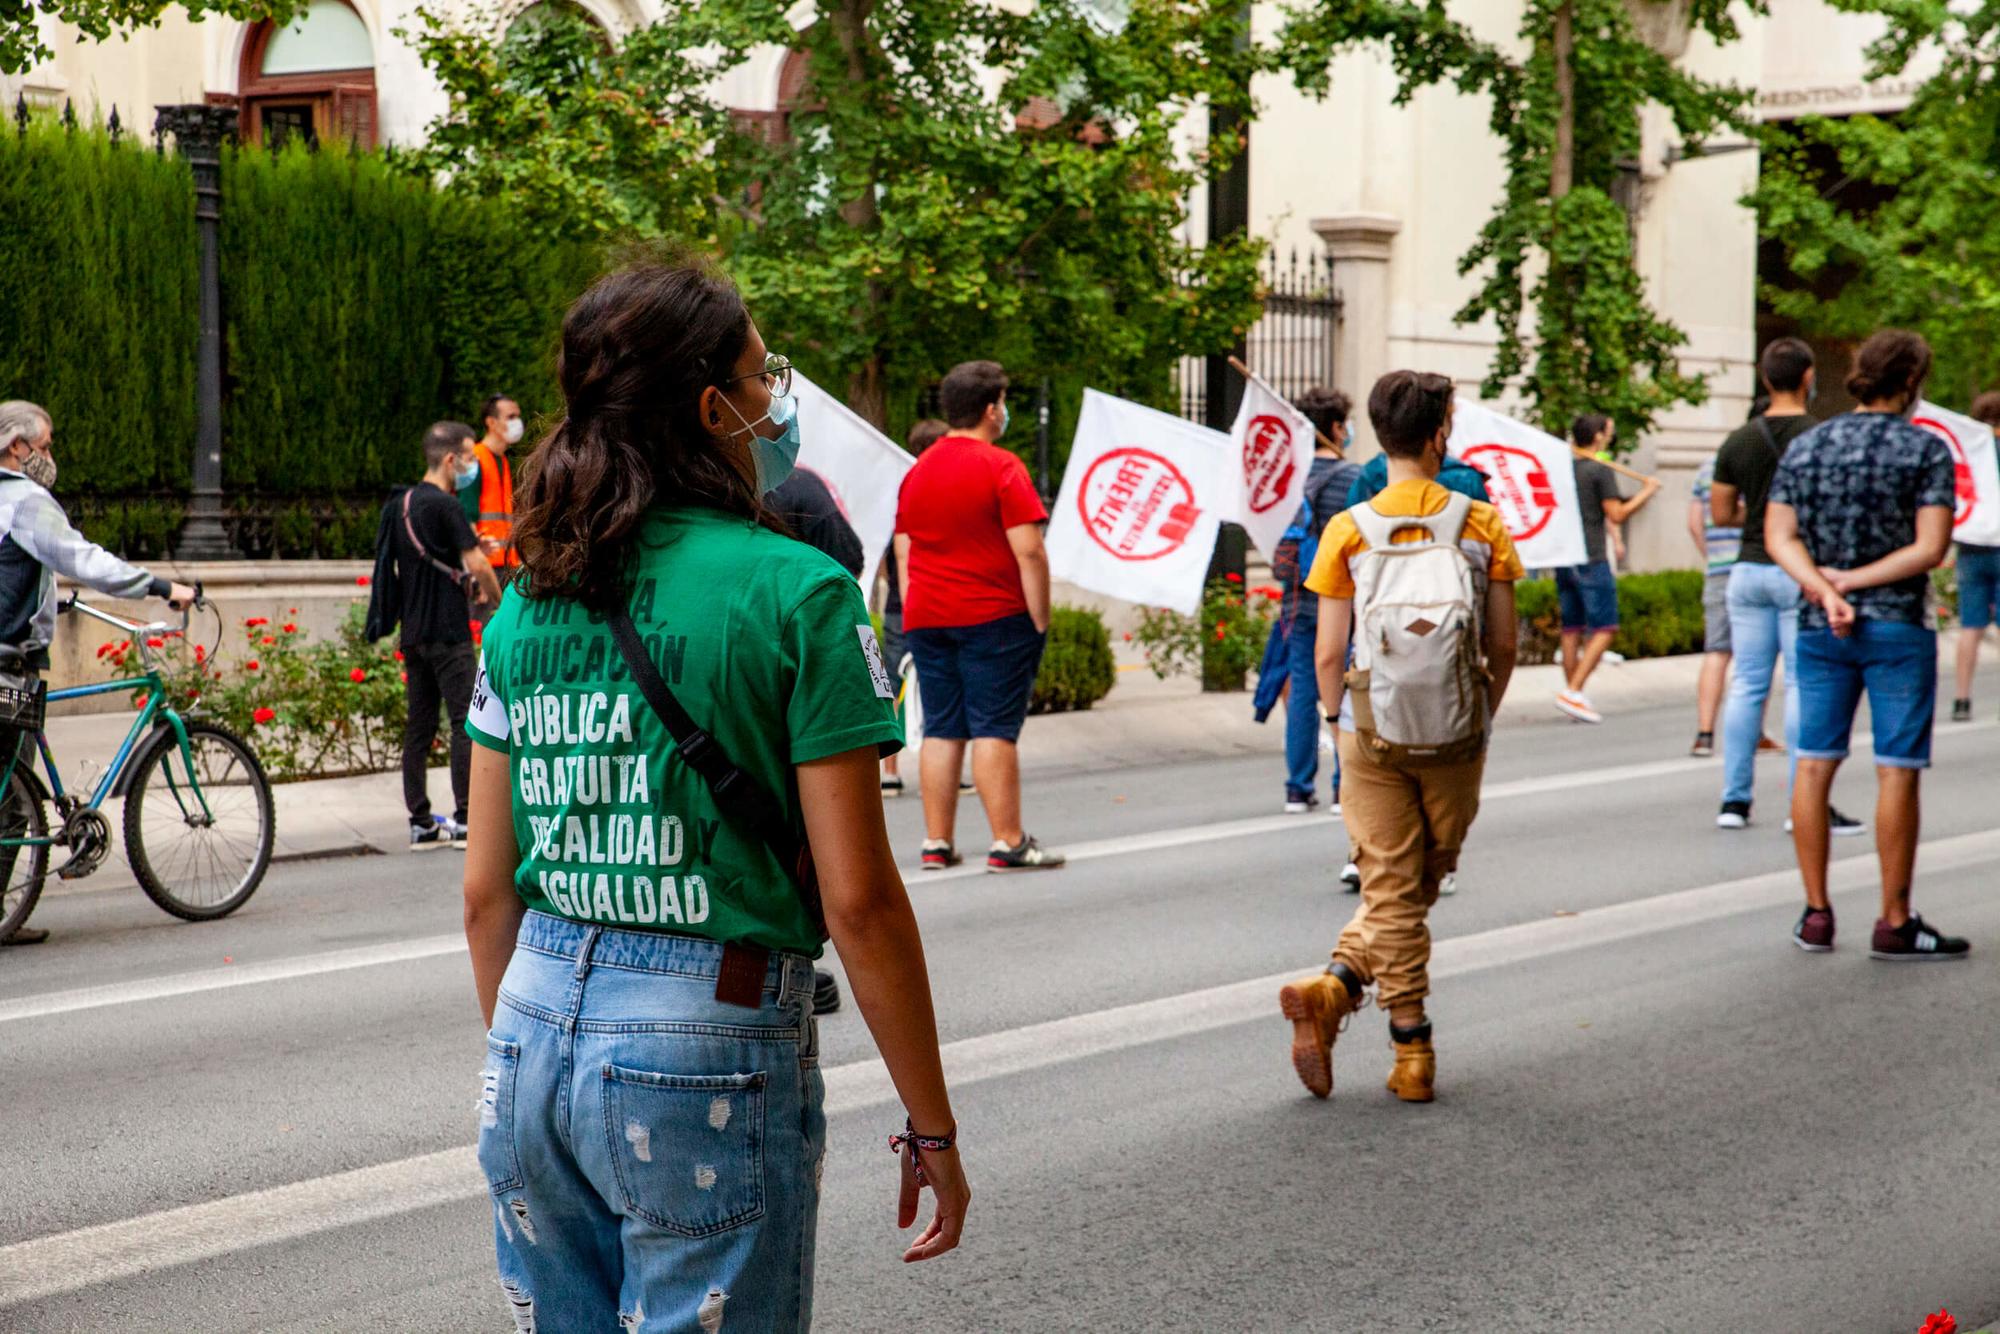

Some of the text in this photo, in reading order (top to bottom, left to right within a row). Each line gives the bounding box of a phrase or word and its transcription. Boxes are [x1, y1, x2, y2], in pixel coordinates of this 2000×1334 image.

[510, 621, 688, 687] EDUCACÓN
[542, 813, 684, 866] CALIDAD
[539, 870, 710, 925] IGUALDAD
